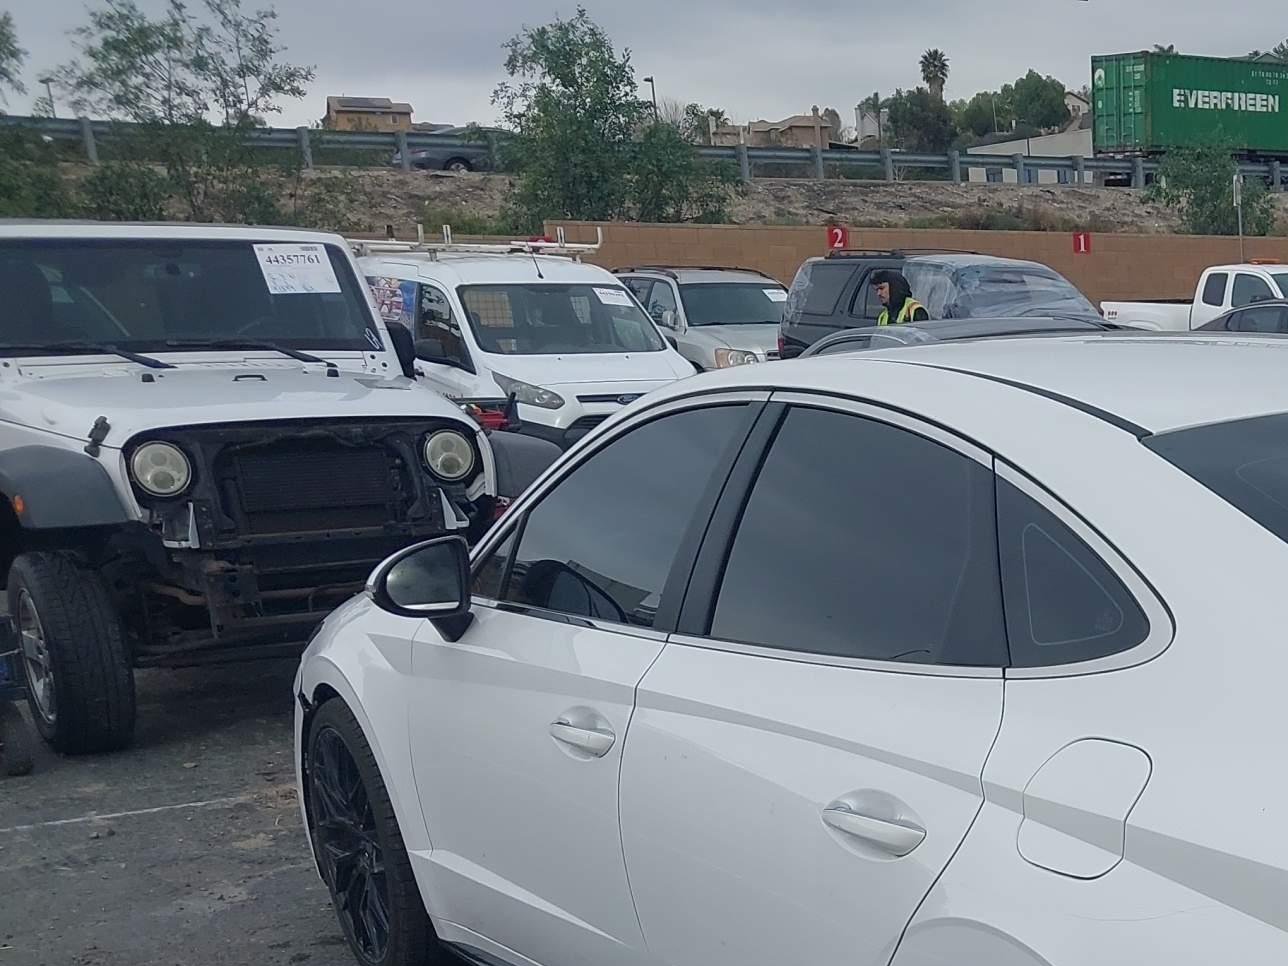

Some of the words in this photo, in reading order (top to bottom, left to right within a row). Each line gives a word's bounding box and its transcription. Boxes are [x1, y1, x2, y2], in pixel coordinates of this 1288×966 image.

[1172, 88, 1280, 113] EVERGREEN
[832, 229, 844, 248] 2
[1078, 234, 1086, 252] 1
[266, 254, 321, 265] 44357761
